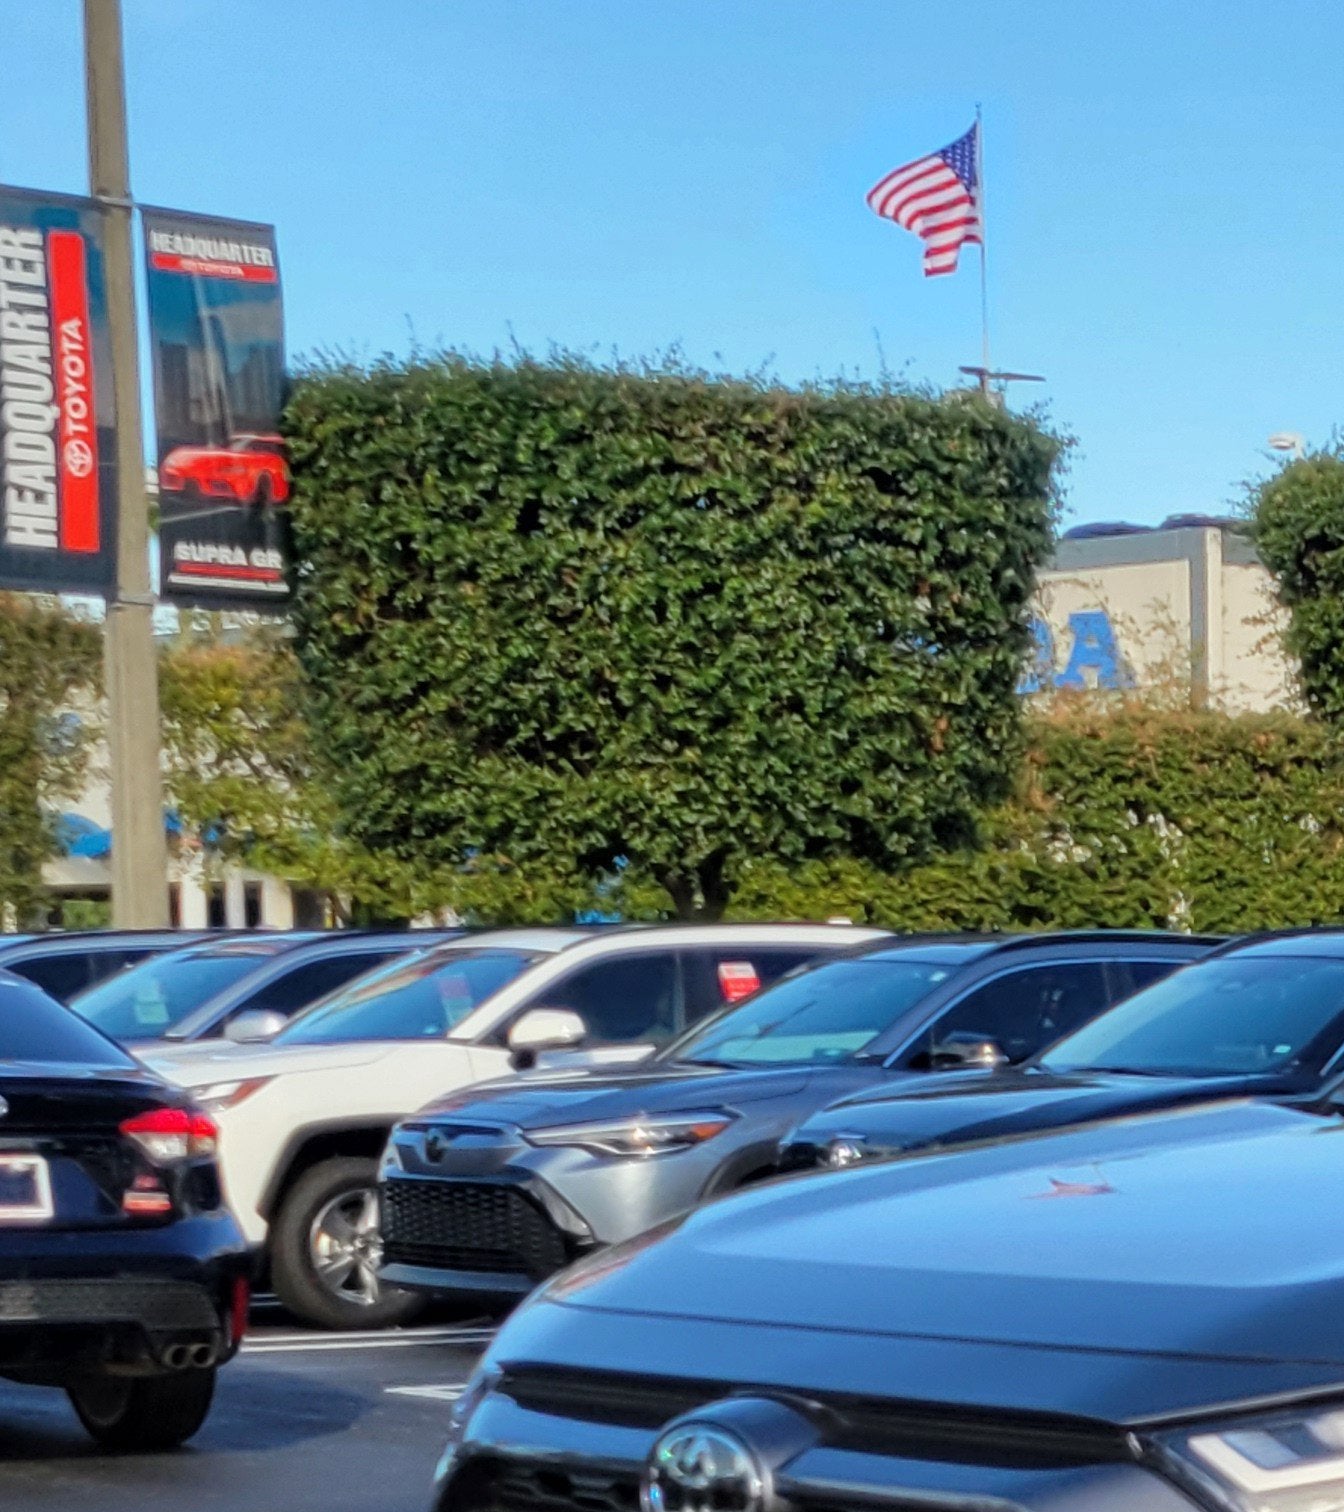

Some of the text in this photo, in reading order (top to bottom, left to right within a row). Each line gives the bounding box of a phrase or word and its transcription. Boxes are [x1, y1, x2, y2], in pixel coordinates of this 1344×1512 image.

[150, 229, 274, 267] HEADQUARTER
[0, 227, 60, 549] HEADQUARTER
[60, 316, 90, 437] TOYOTA
[174, 540, 283, 569] SUPRA GR
